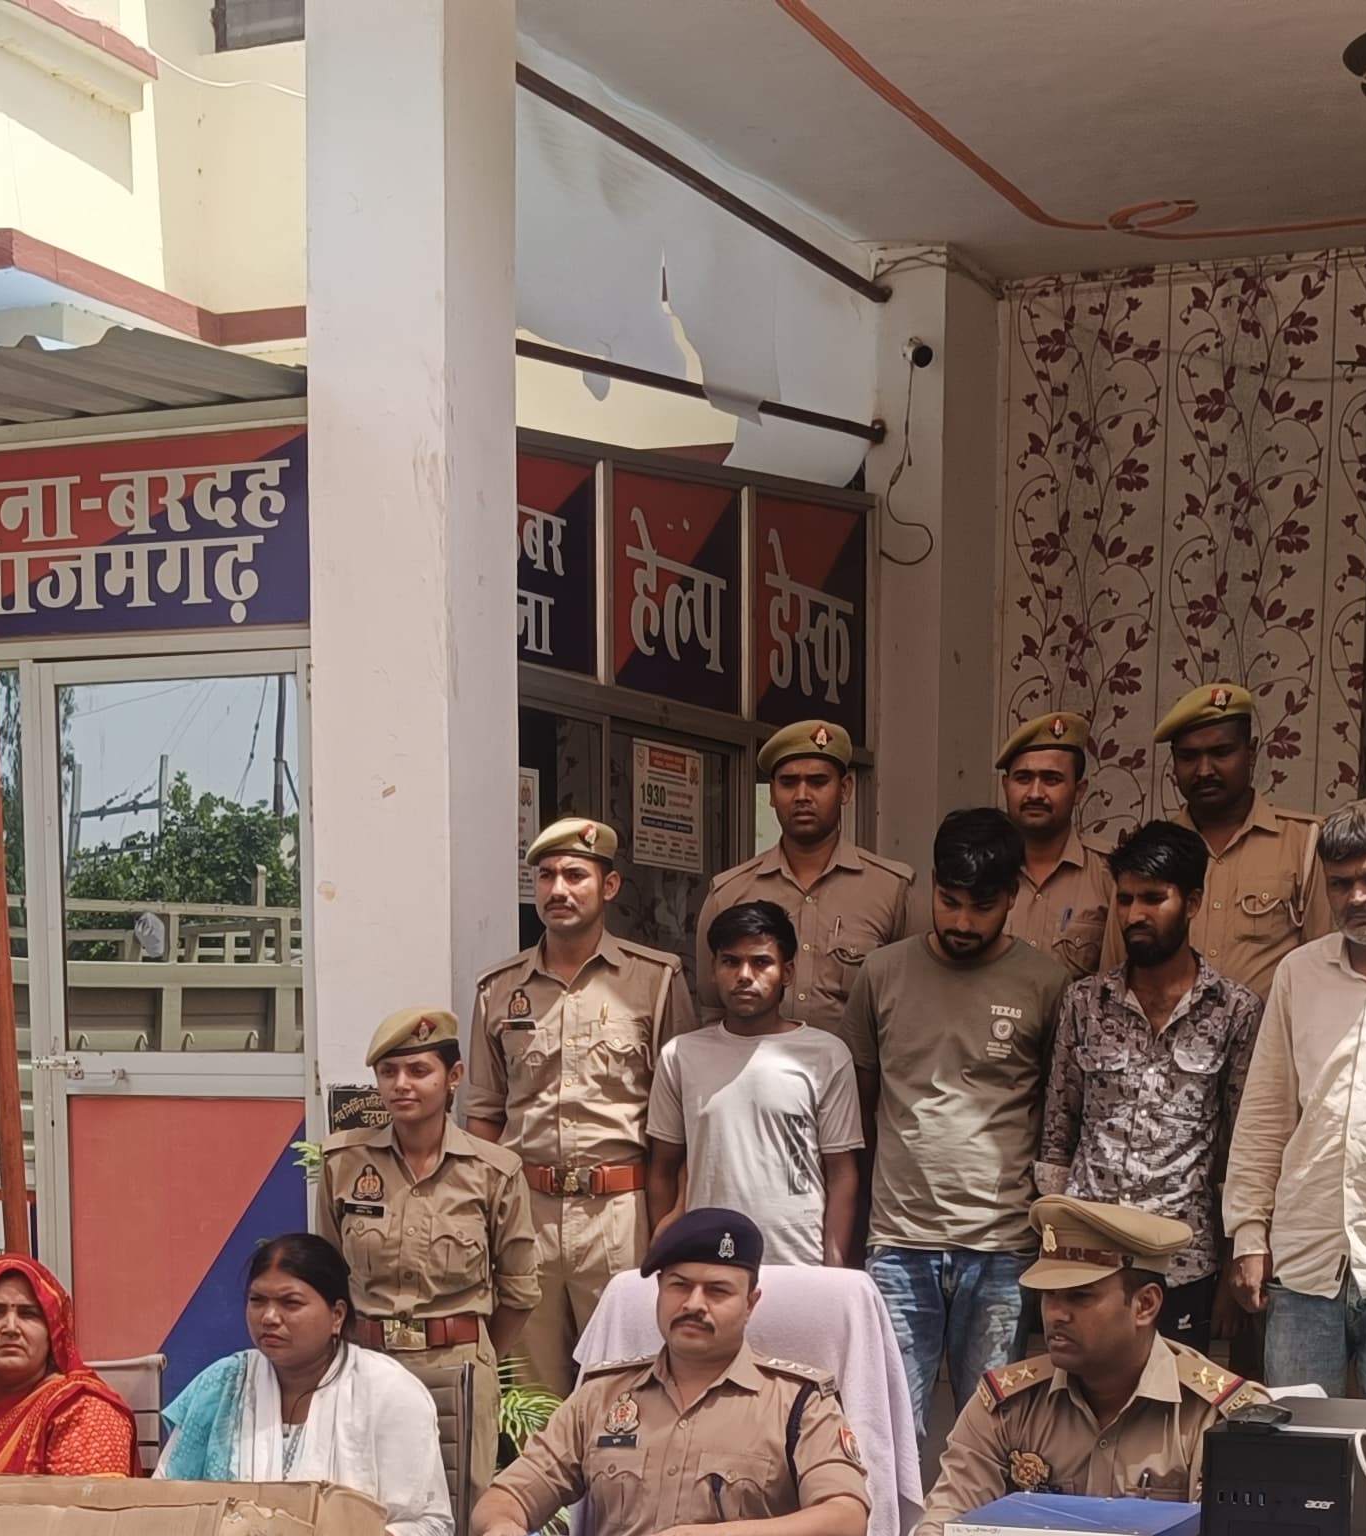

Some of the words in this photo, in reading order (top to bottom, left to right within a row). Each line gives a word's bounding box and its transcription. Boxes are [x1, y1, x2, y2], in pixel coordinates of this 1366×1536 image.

[517, 504, 567, 577] बर
[626, 506, 727, 674] हेल्प
[765, 527, 854, 705] डेस्क
[640, 782, 667, 807] 1930
[990, 1005, 1022, 1019] TEXAS
[1304, 1500, 1335, 1510] acer
